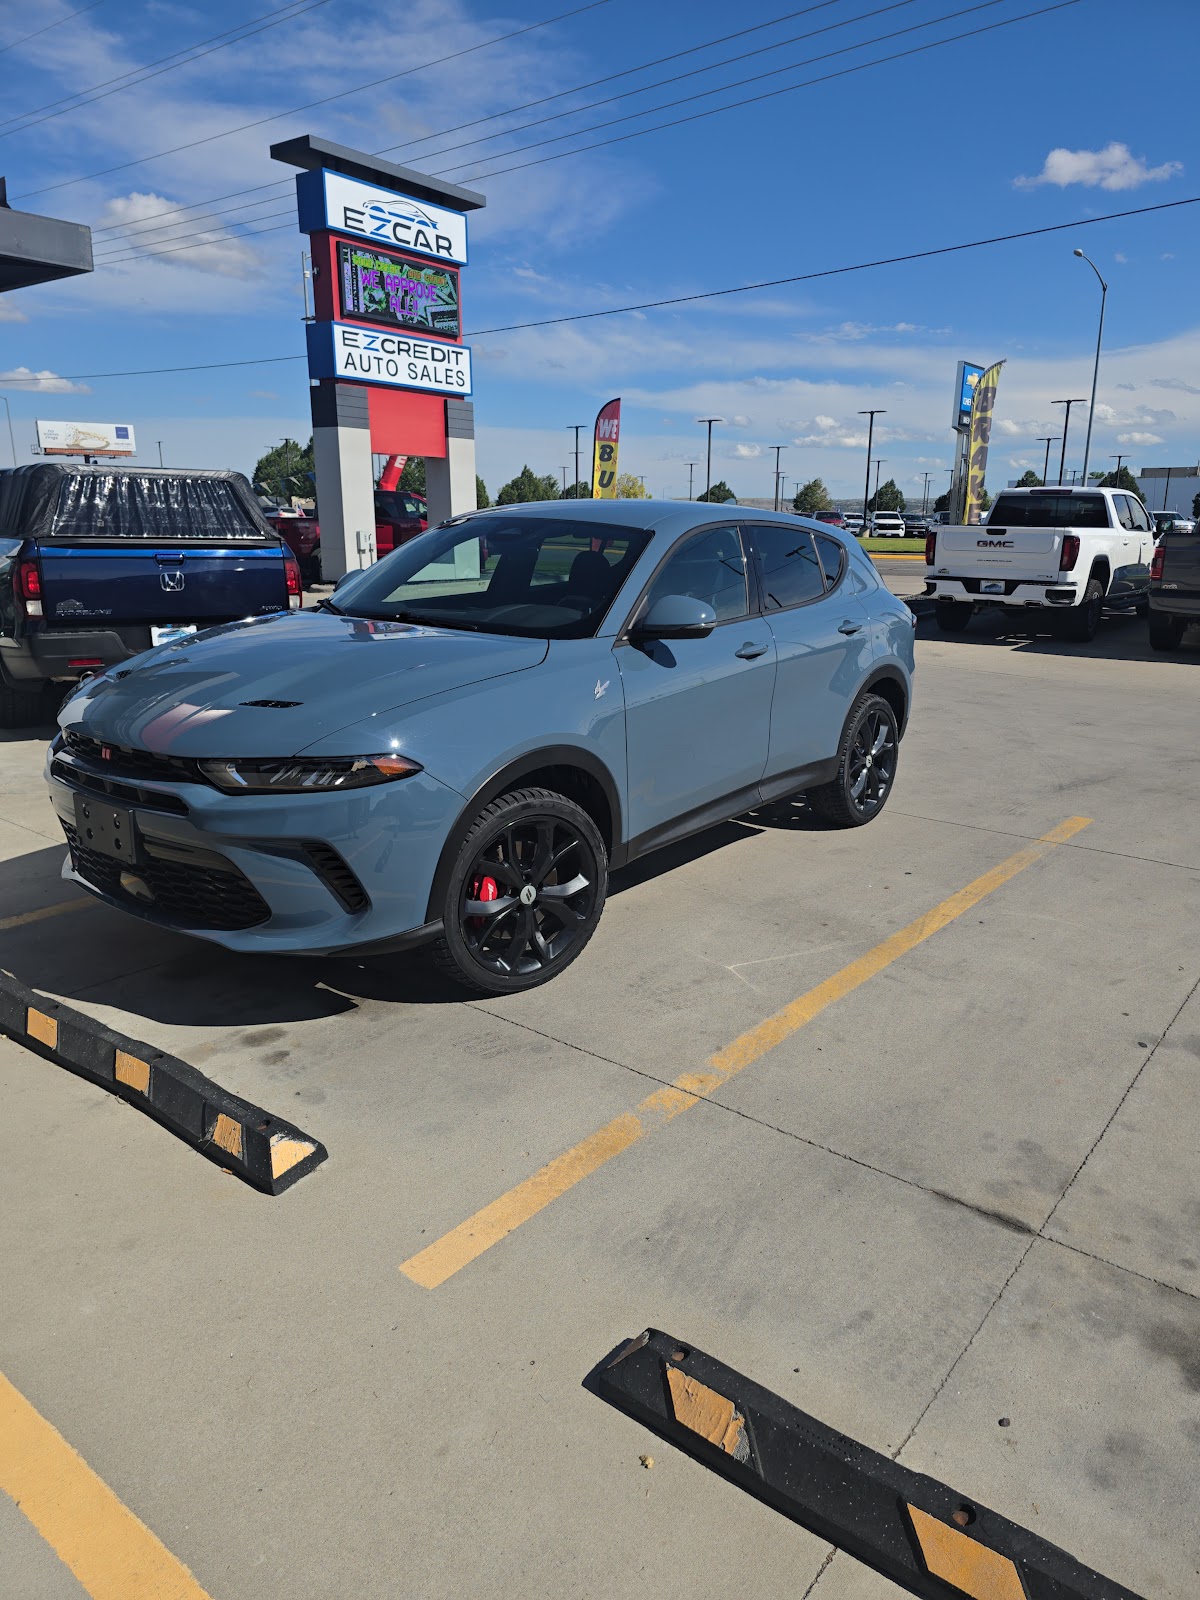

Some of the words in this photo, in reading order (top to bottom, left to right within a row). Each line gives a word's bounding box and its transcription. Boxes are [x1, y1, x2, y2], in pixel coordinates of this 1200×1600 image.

[359, 268, 380, 289] WE
[385, 274, 438, 302] APPROVE
[343, 352, 399, 377] AUTO
[407, 362, 466, 388] SALES
[598, 418, 618, 439] WE
[977, 540, 1014, 548] GMC
